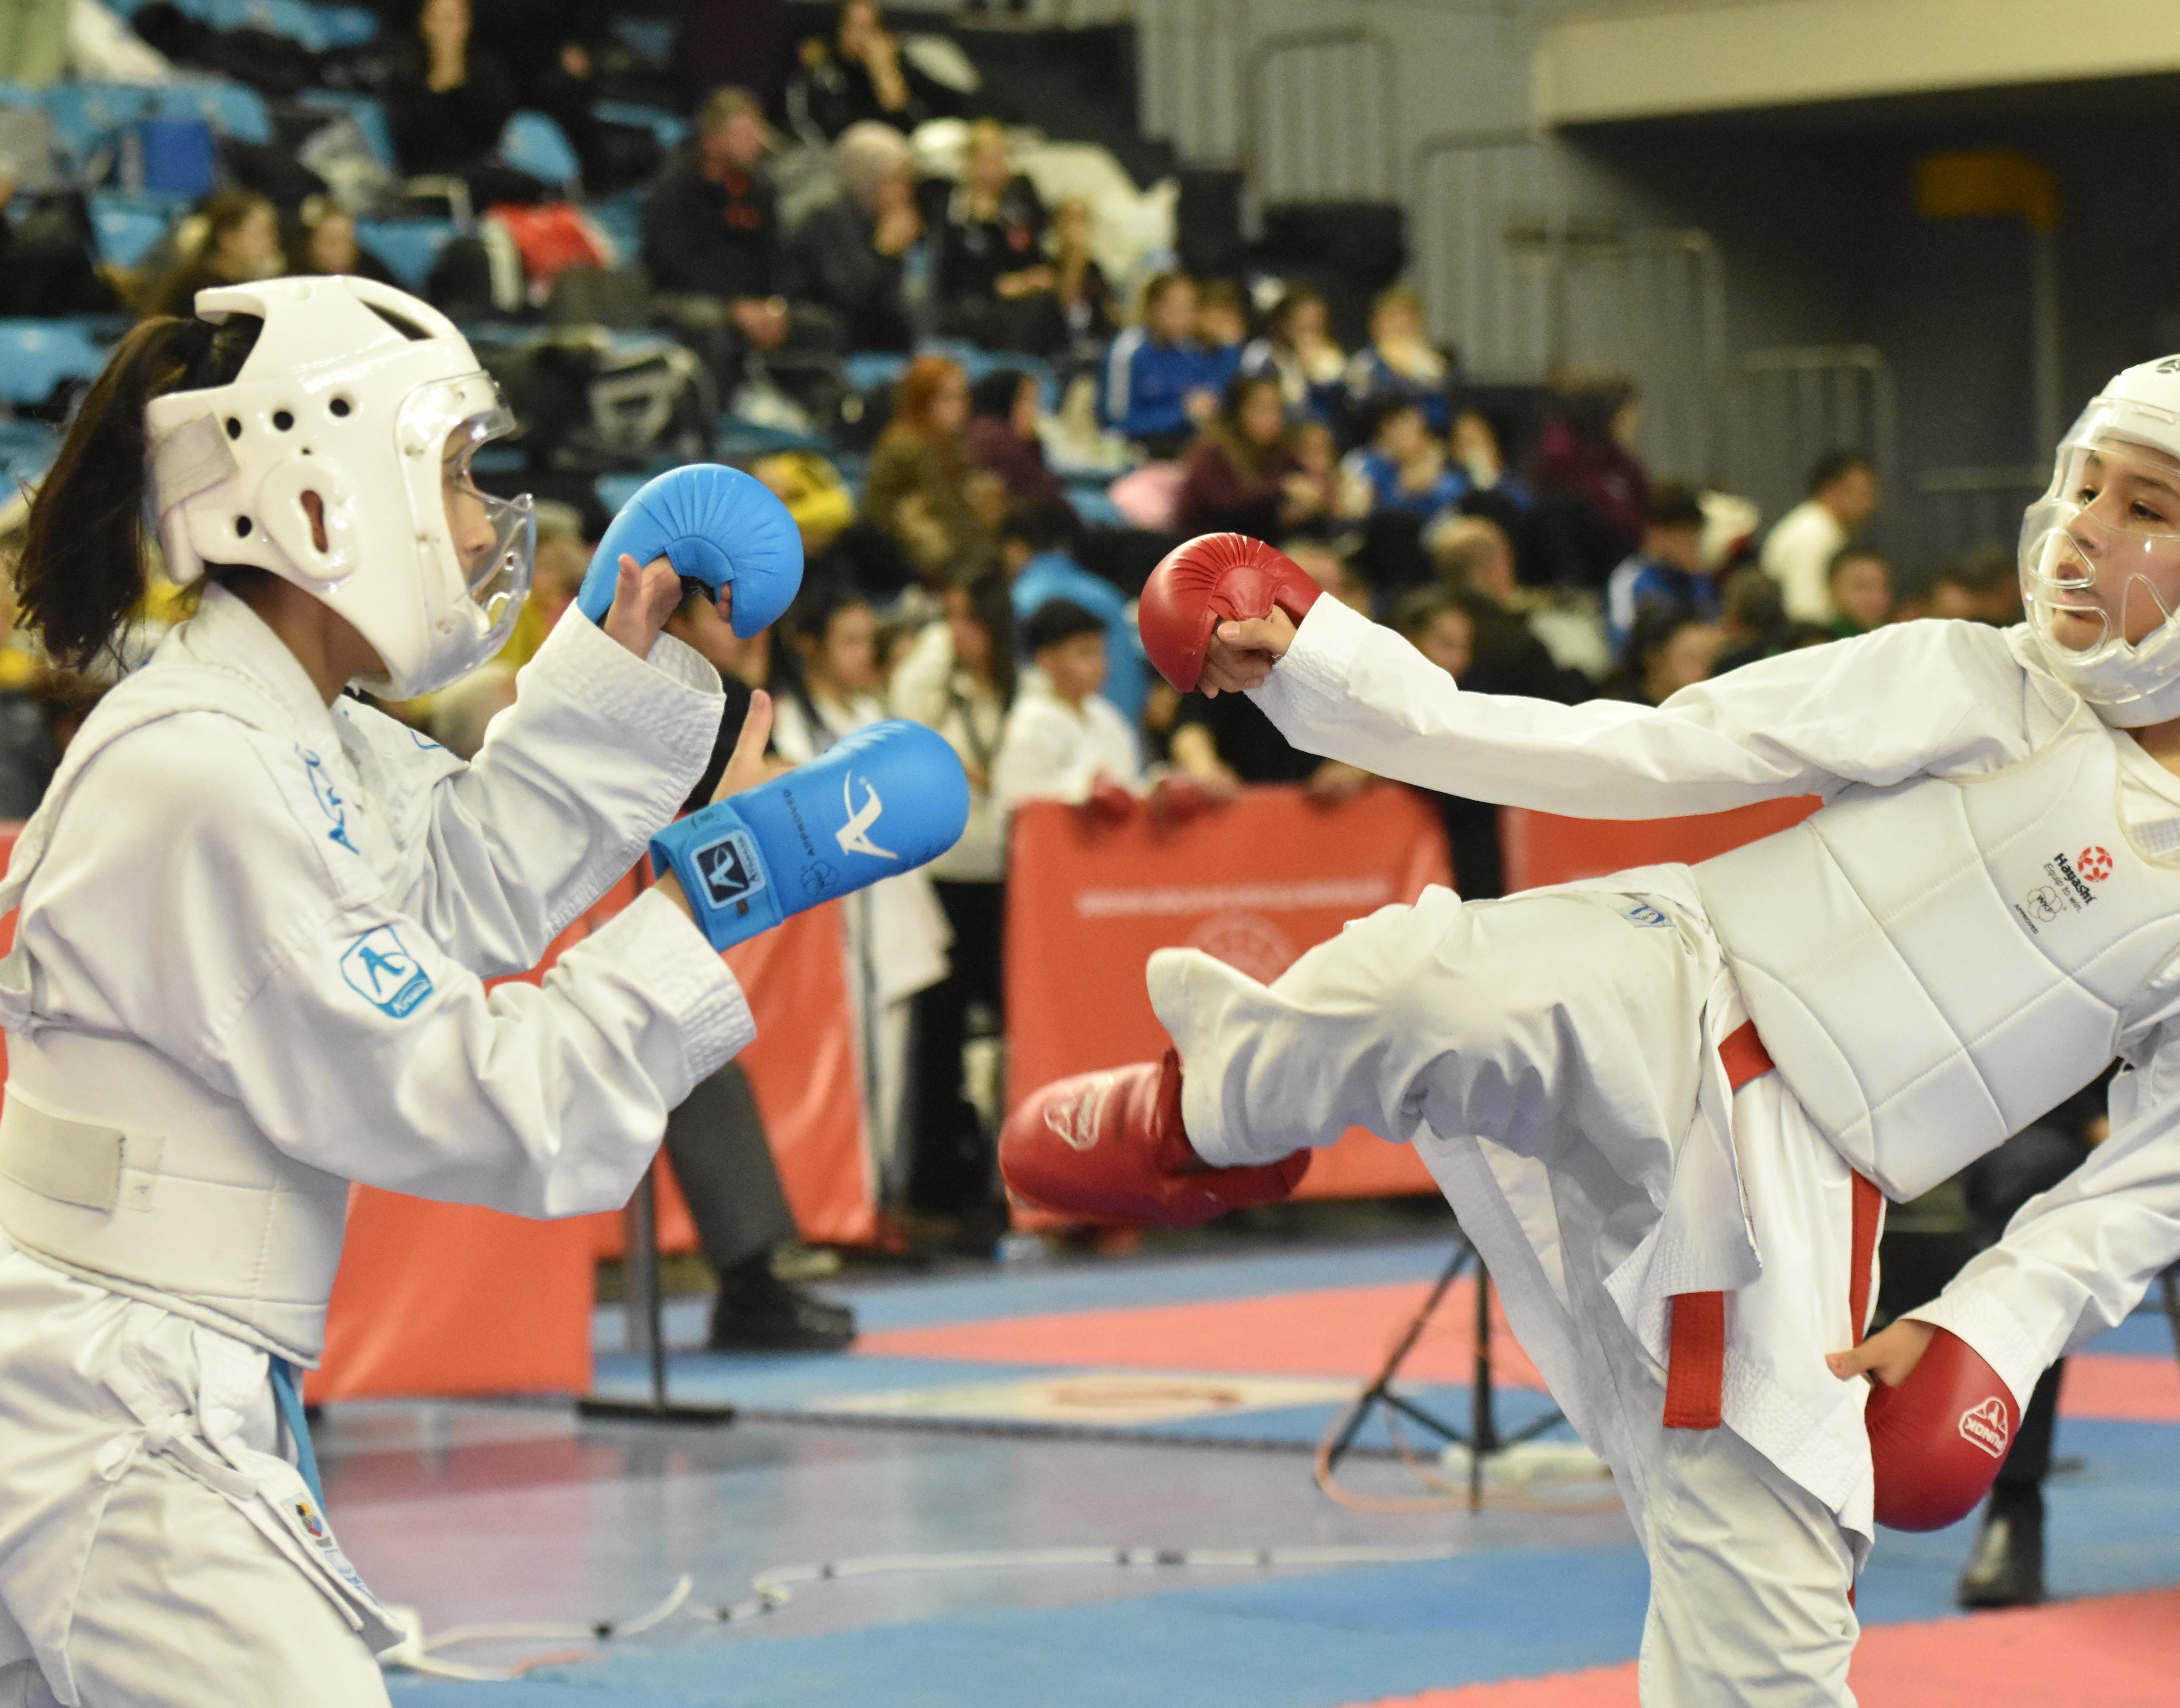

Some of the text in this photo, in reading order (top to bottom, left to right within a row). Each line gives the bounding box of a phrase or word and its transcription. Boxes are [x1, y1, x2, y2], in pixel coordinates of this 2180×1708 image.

[783, 789, 815, 856] APPROVED
[2036, 895, 2054, 912] WKF
[2043, 862, 2082, 913] Equip to win.
[2054, 853, 2097, 905] Hayashi
[2014, 904, 2039, 934] APPROVED
